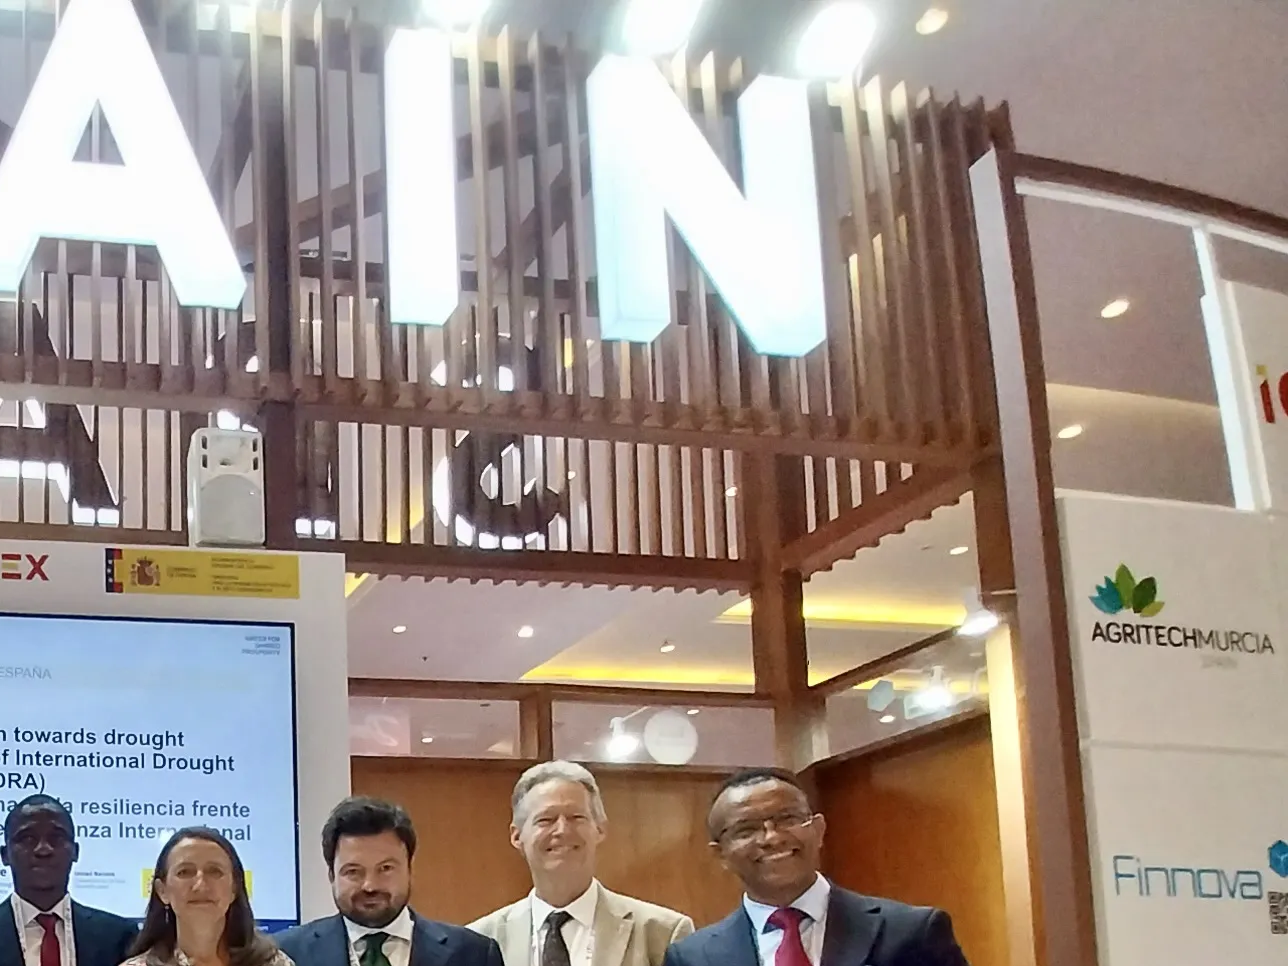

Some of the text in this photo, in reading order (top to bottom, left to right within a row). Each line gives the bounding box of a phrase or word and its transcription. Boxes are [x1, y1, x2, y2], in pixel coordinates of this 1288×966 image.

[13, 726, 97, 744] towards
[103, 729, 185, 750] drought
[15, 749, 145, 769] International
[153, 753, 235, 775] Drought
[80, 798, 185, 816] resiliencia
[192, 799, 251, 818] frente
[1113, 855, 1263, 900] Finnova
